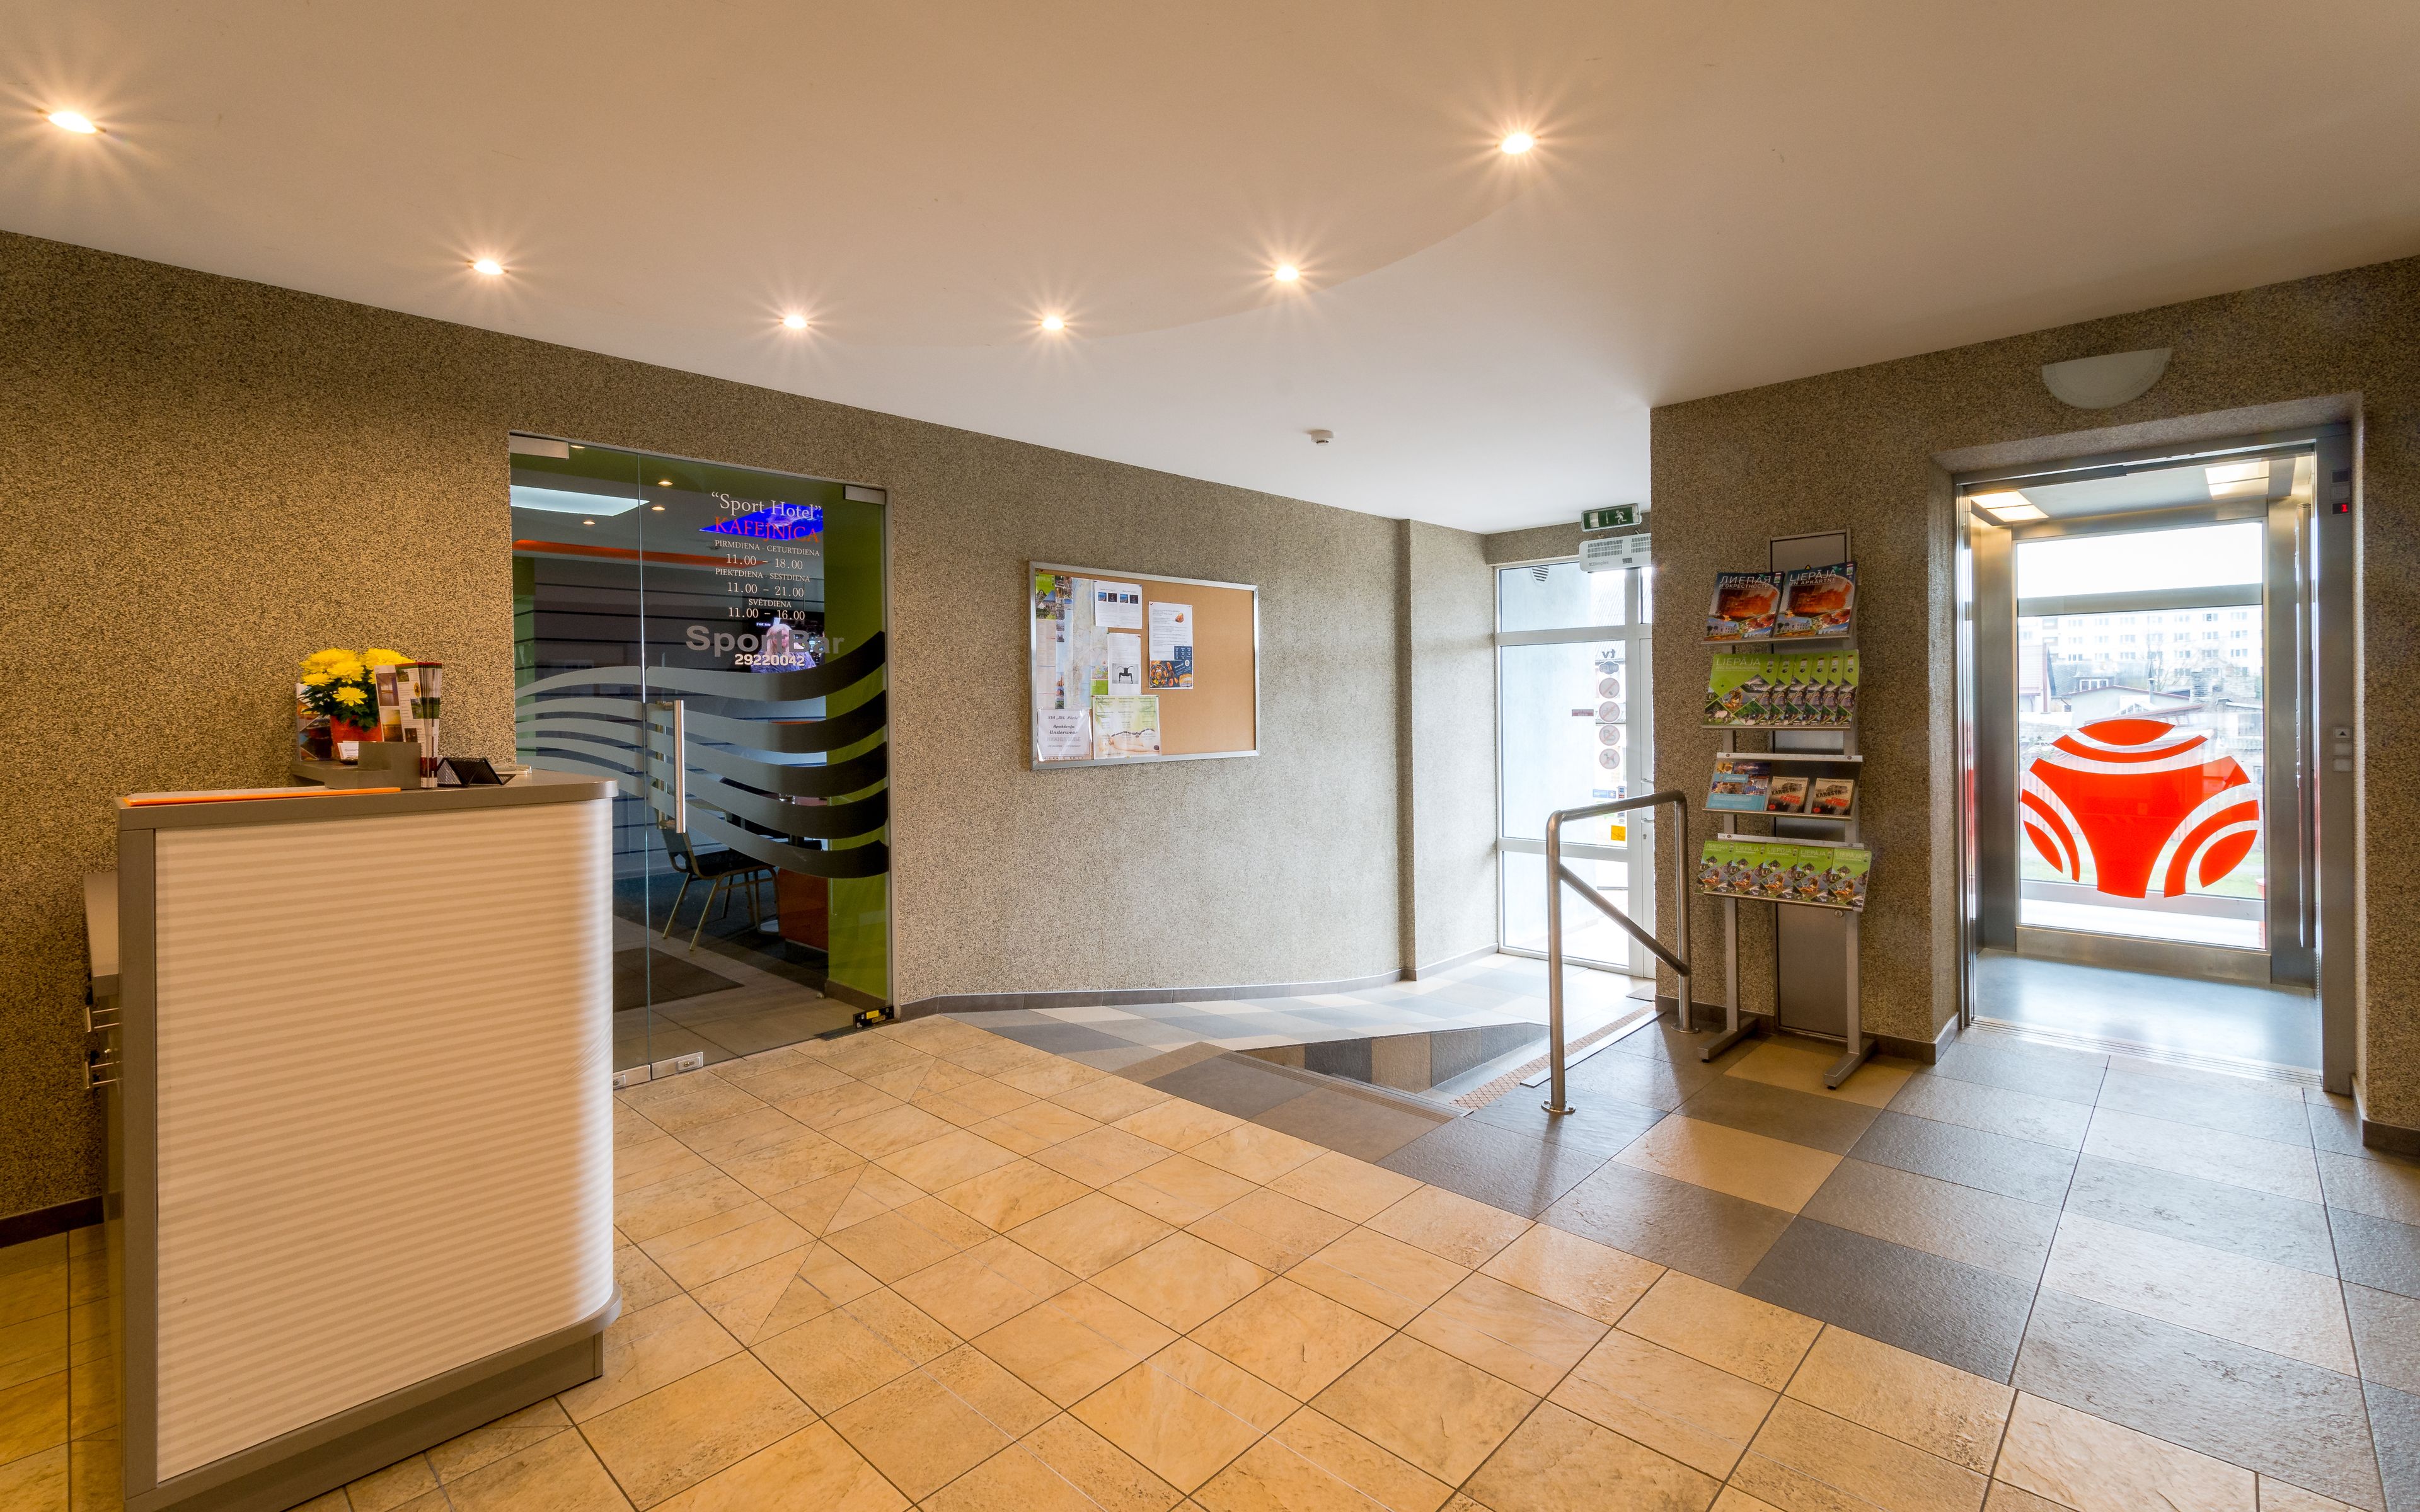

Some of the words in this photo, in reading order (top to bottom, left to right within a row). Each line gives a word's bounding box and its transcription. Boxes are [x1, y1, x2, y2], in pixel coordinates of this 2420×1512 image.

[712, 491, 764, 516] “Sport
[771, 500, 821, 519] Hotel”
[2341, 504, 2348, 512] 1
[715, 539, 760, 550] PIRMDIENA
[766, 545, 819, 556] CETURTDIENA
[726, 554, 756, 565] 11.00
[775, 558, 803, 570] 18.00
[715, 568, 763, 578] PIEKTDIENA
[769, 573, 810, 582] SESTDIENA
[1790, 569, 1836, 581] LIEPĀJA
[727, 582, 757, 593] 11.00
[775, 586, 804, 597] 21.00
[749, 598, 792, 607] SVĒTDIENA
[729, 607, 758, 618] 11.00
[777, 610, 805, 621] 16.00
[735, 654, 805, 666] 29220042
[1716, 656, 1760, 666] LIEPĀJA
